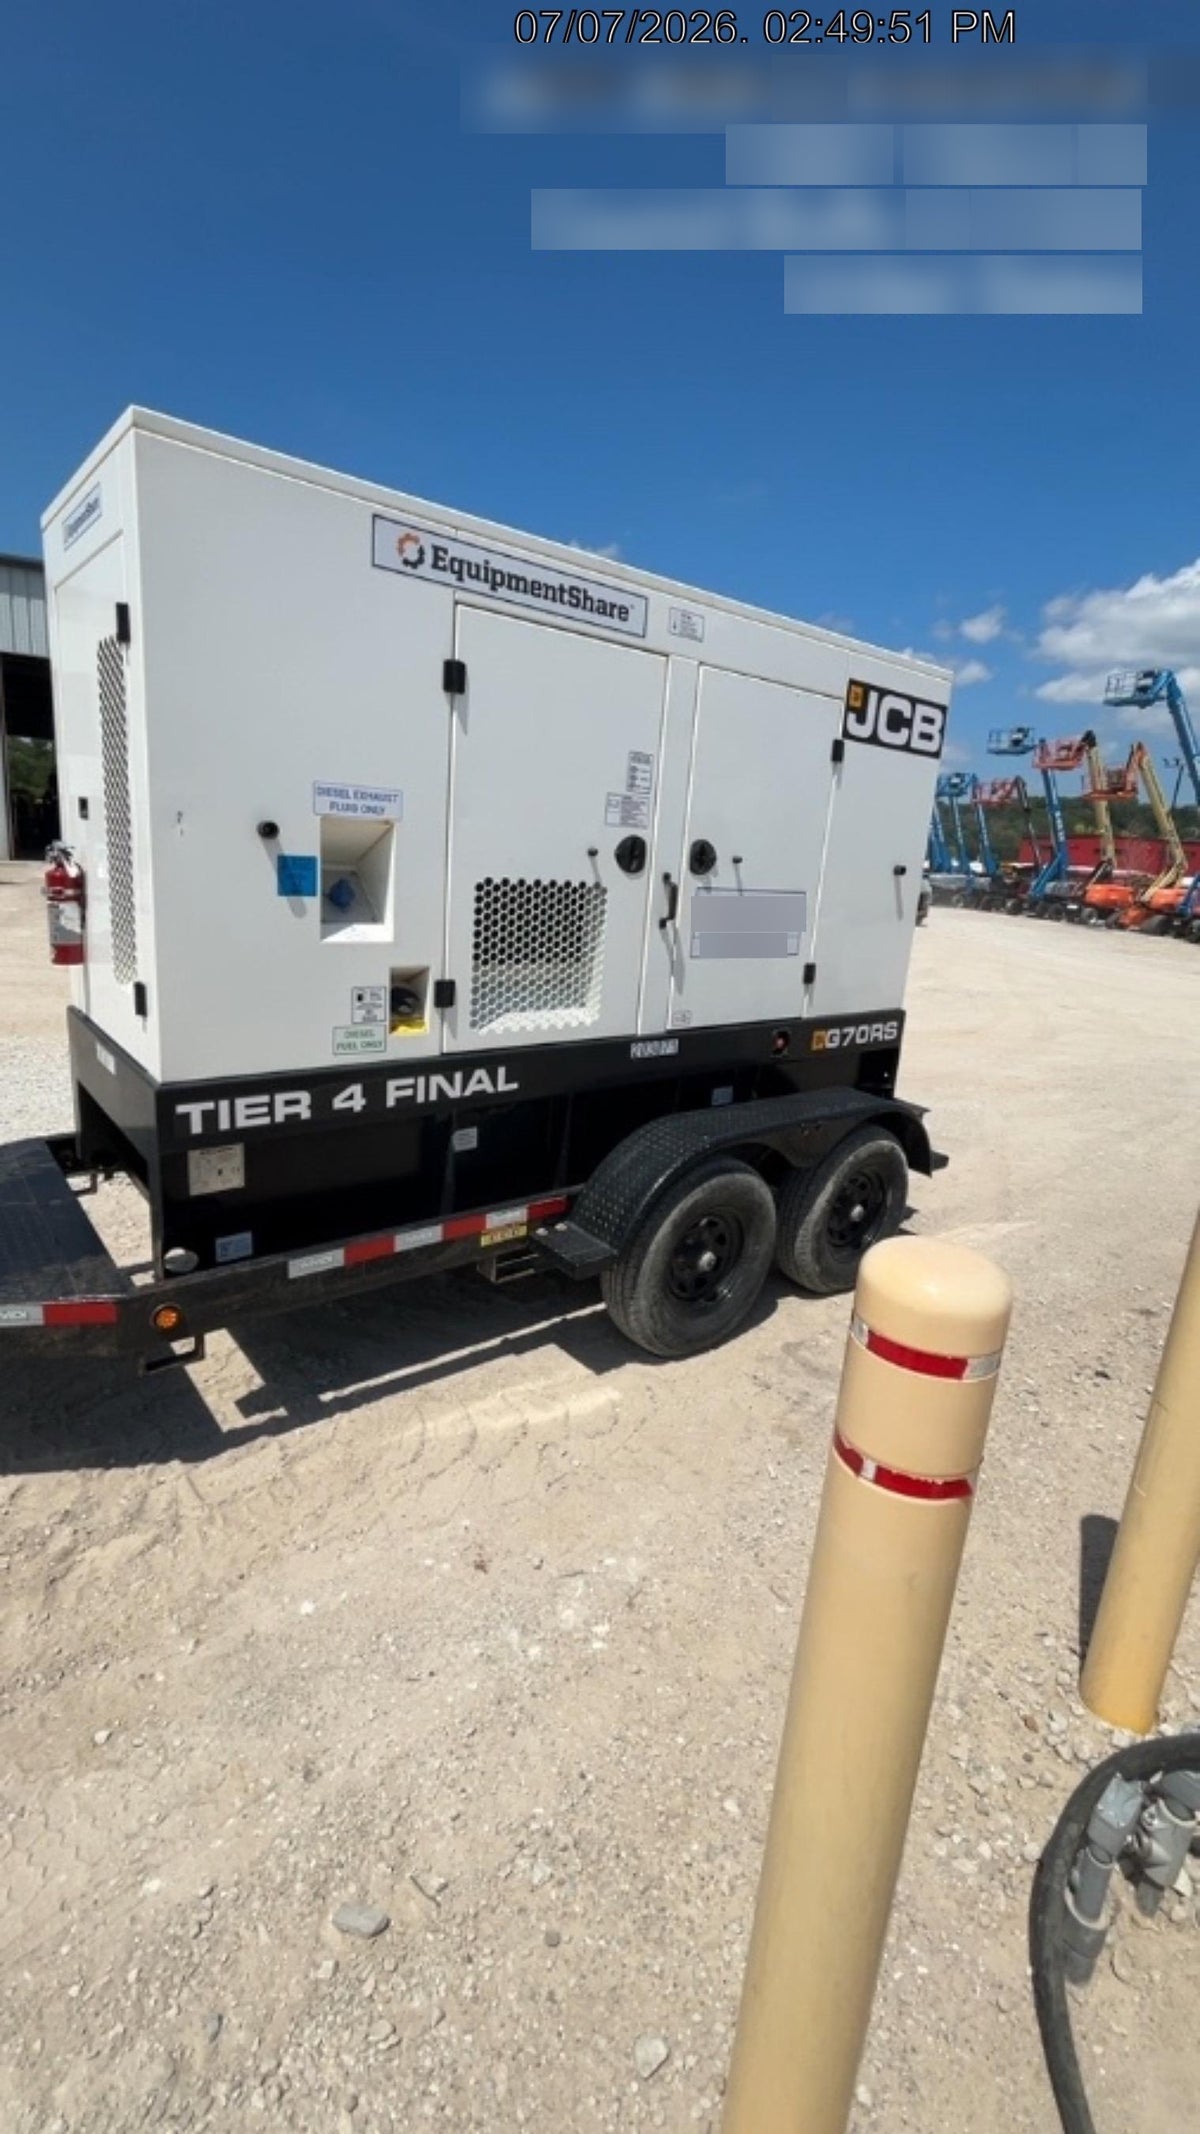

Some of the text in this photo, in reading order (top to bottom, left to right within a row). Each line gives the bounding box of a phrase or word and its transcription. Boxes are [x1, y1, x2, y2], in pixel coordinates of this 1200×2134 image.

[431, 543, 631, 622] EquipmentShare
[845, 685, 944, 753] JCB
[176, 1066, 519, 1135] TIER 4 FINAL
